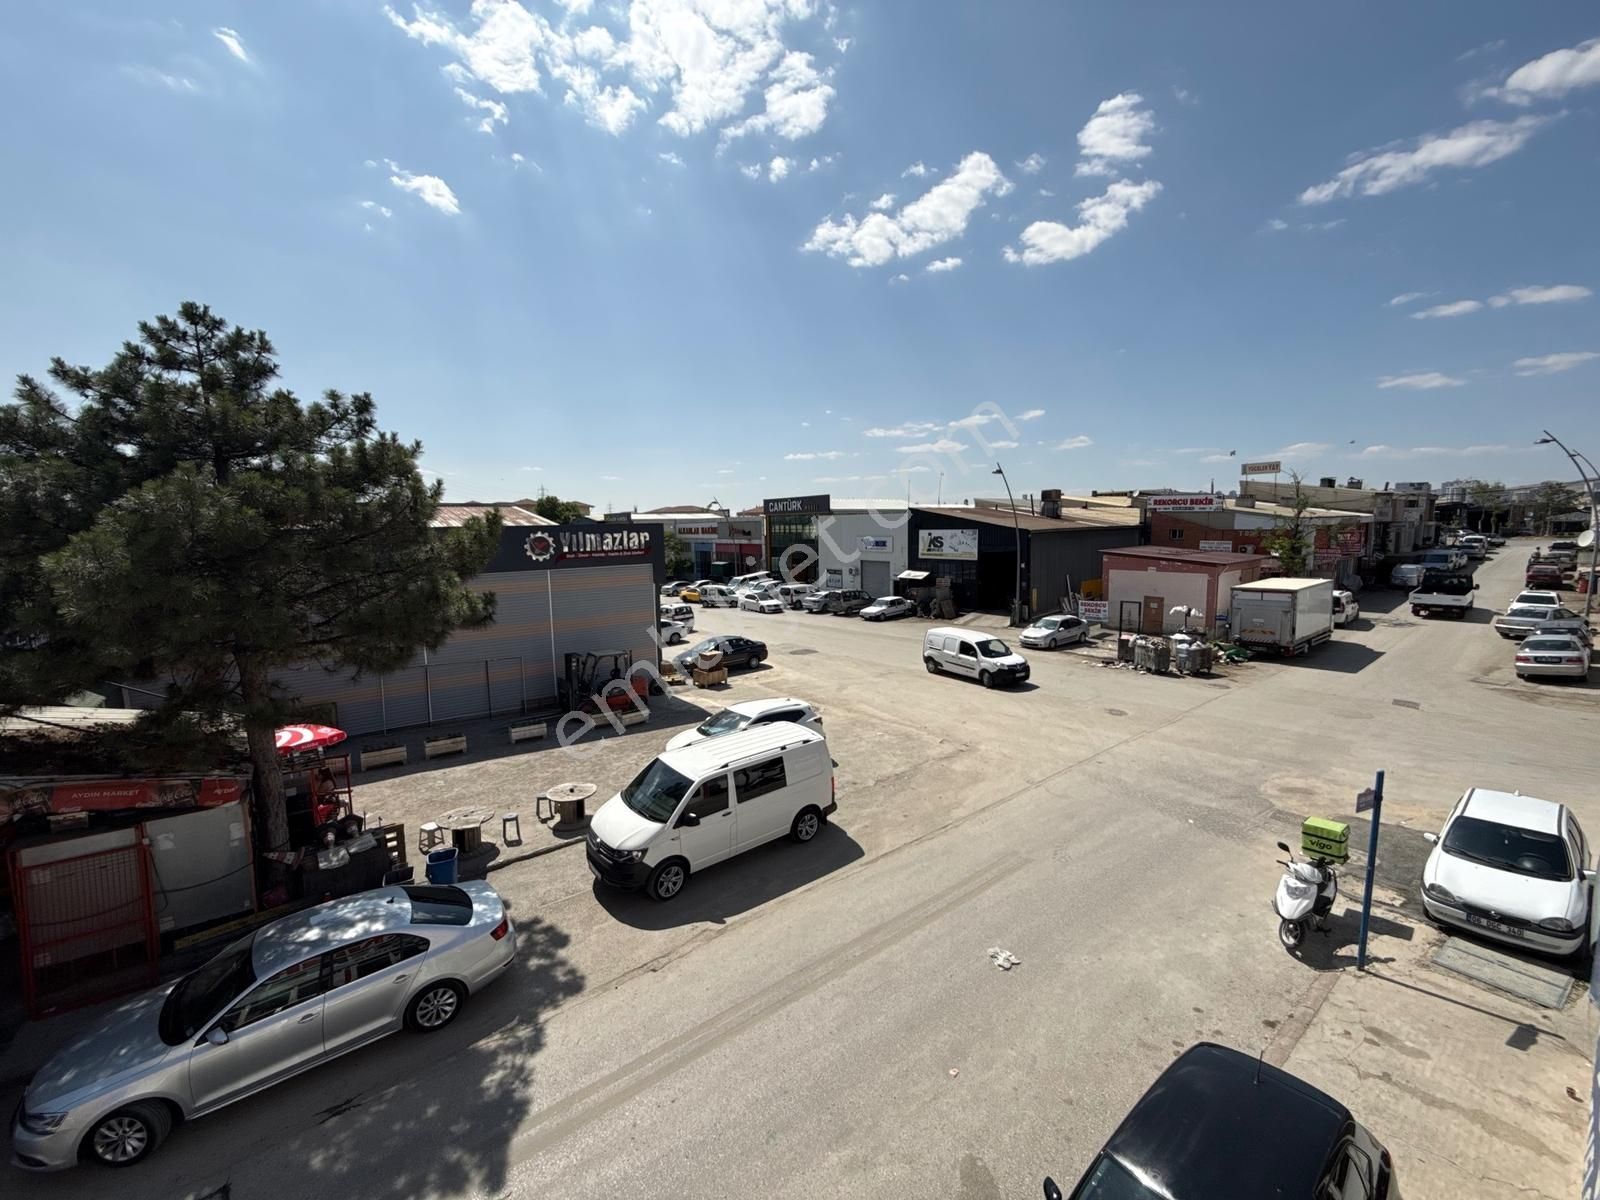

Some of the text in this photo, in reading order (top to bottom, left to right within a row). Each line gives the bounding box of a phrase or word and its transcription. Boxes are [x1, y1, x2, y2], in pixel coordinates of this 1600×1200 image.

[768, 499, 803, 512] CANTÜRK
[71, 789, 141, 799] AYDIN MARKET
[1309, 840, 1333, 850] vigo
